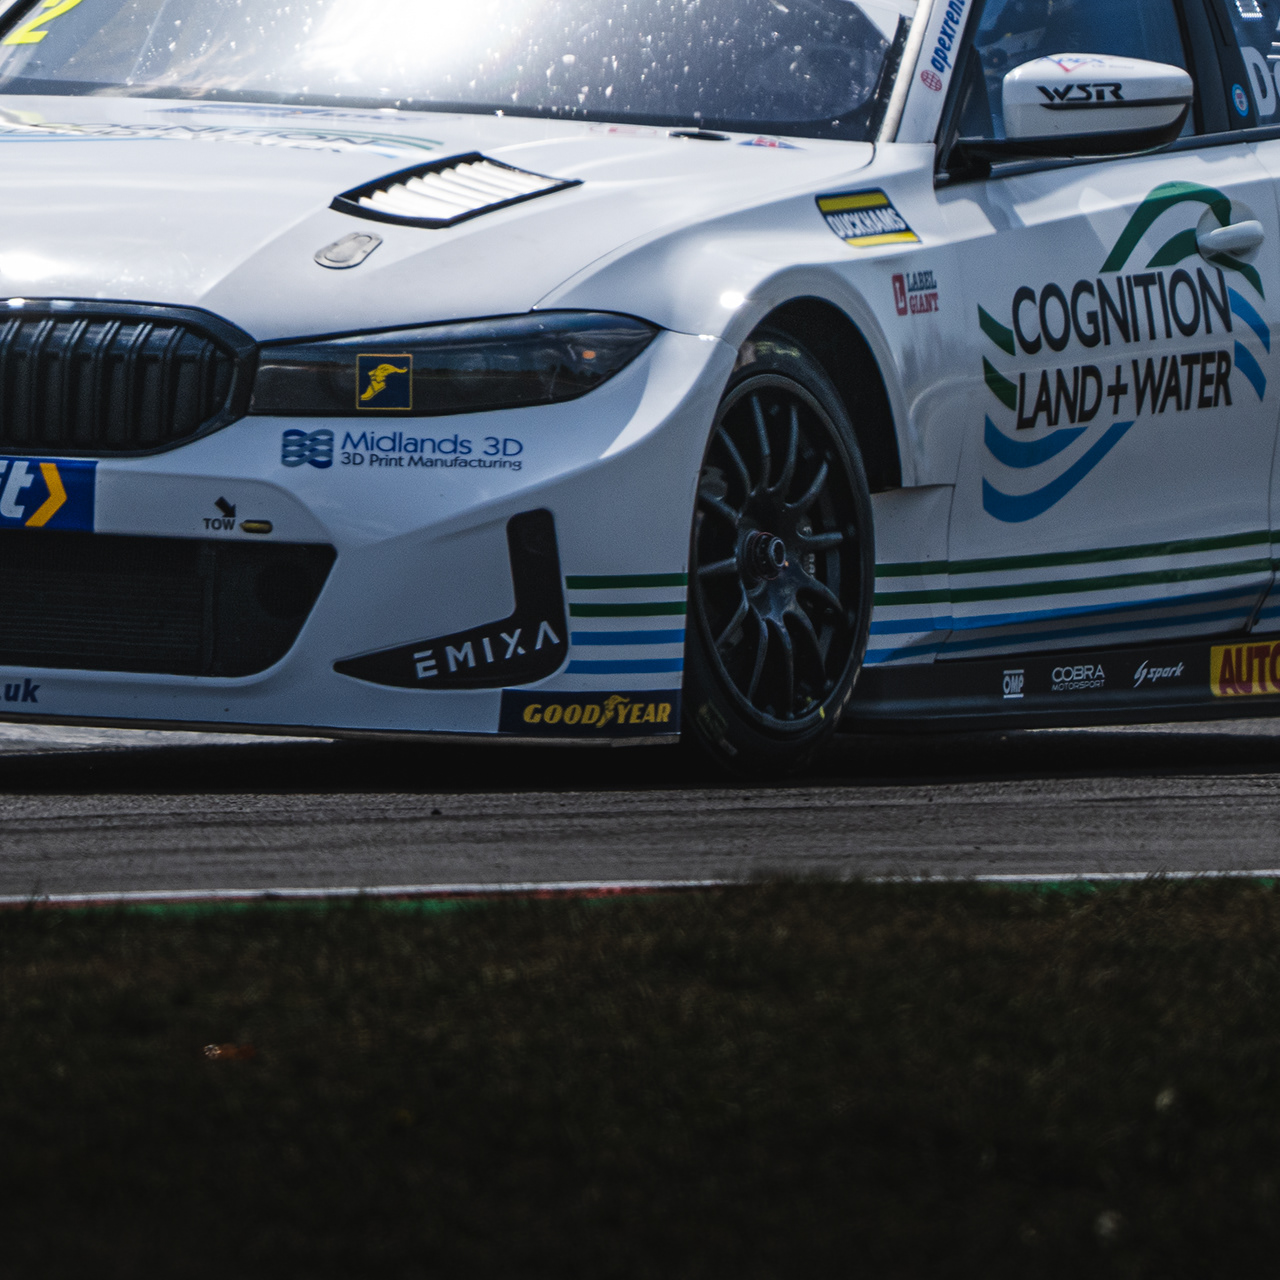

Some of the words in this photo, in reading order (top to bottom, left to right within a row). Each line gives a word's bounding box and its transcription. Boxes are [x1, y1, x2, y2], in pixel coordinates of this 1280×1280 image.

[827, 208, 907, 237] DUCKHAMS
[906, 271, 937, 293] LABEL
[909, 293, 939, 314] GIANT
[1011, 267, 1234, 356] COGNITION
[341, 431, 472, 455] Midlands
[483, 436, 523, 456] 3D
[341, 452, 364, 466] 3D
[370, 454, 403, 468] Print
[408, 455, 522, 471] Manufacturing
[203, 518, 236, 531] TOW
[413, 620, 560, 680] EMIXA
[1051, 664, 1106, 683] COBRA
[1003, 674, 1025, 695] OMP
[1051, 679, 1106, 692] MOTORSPORT
